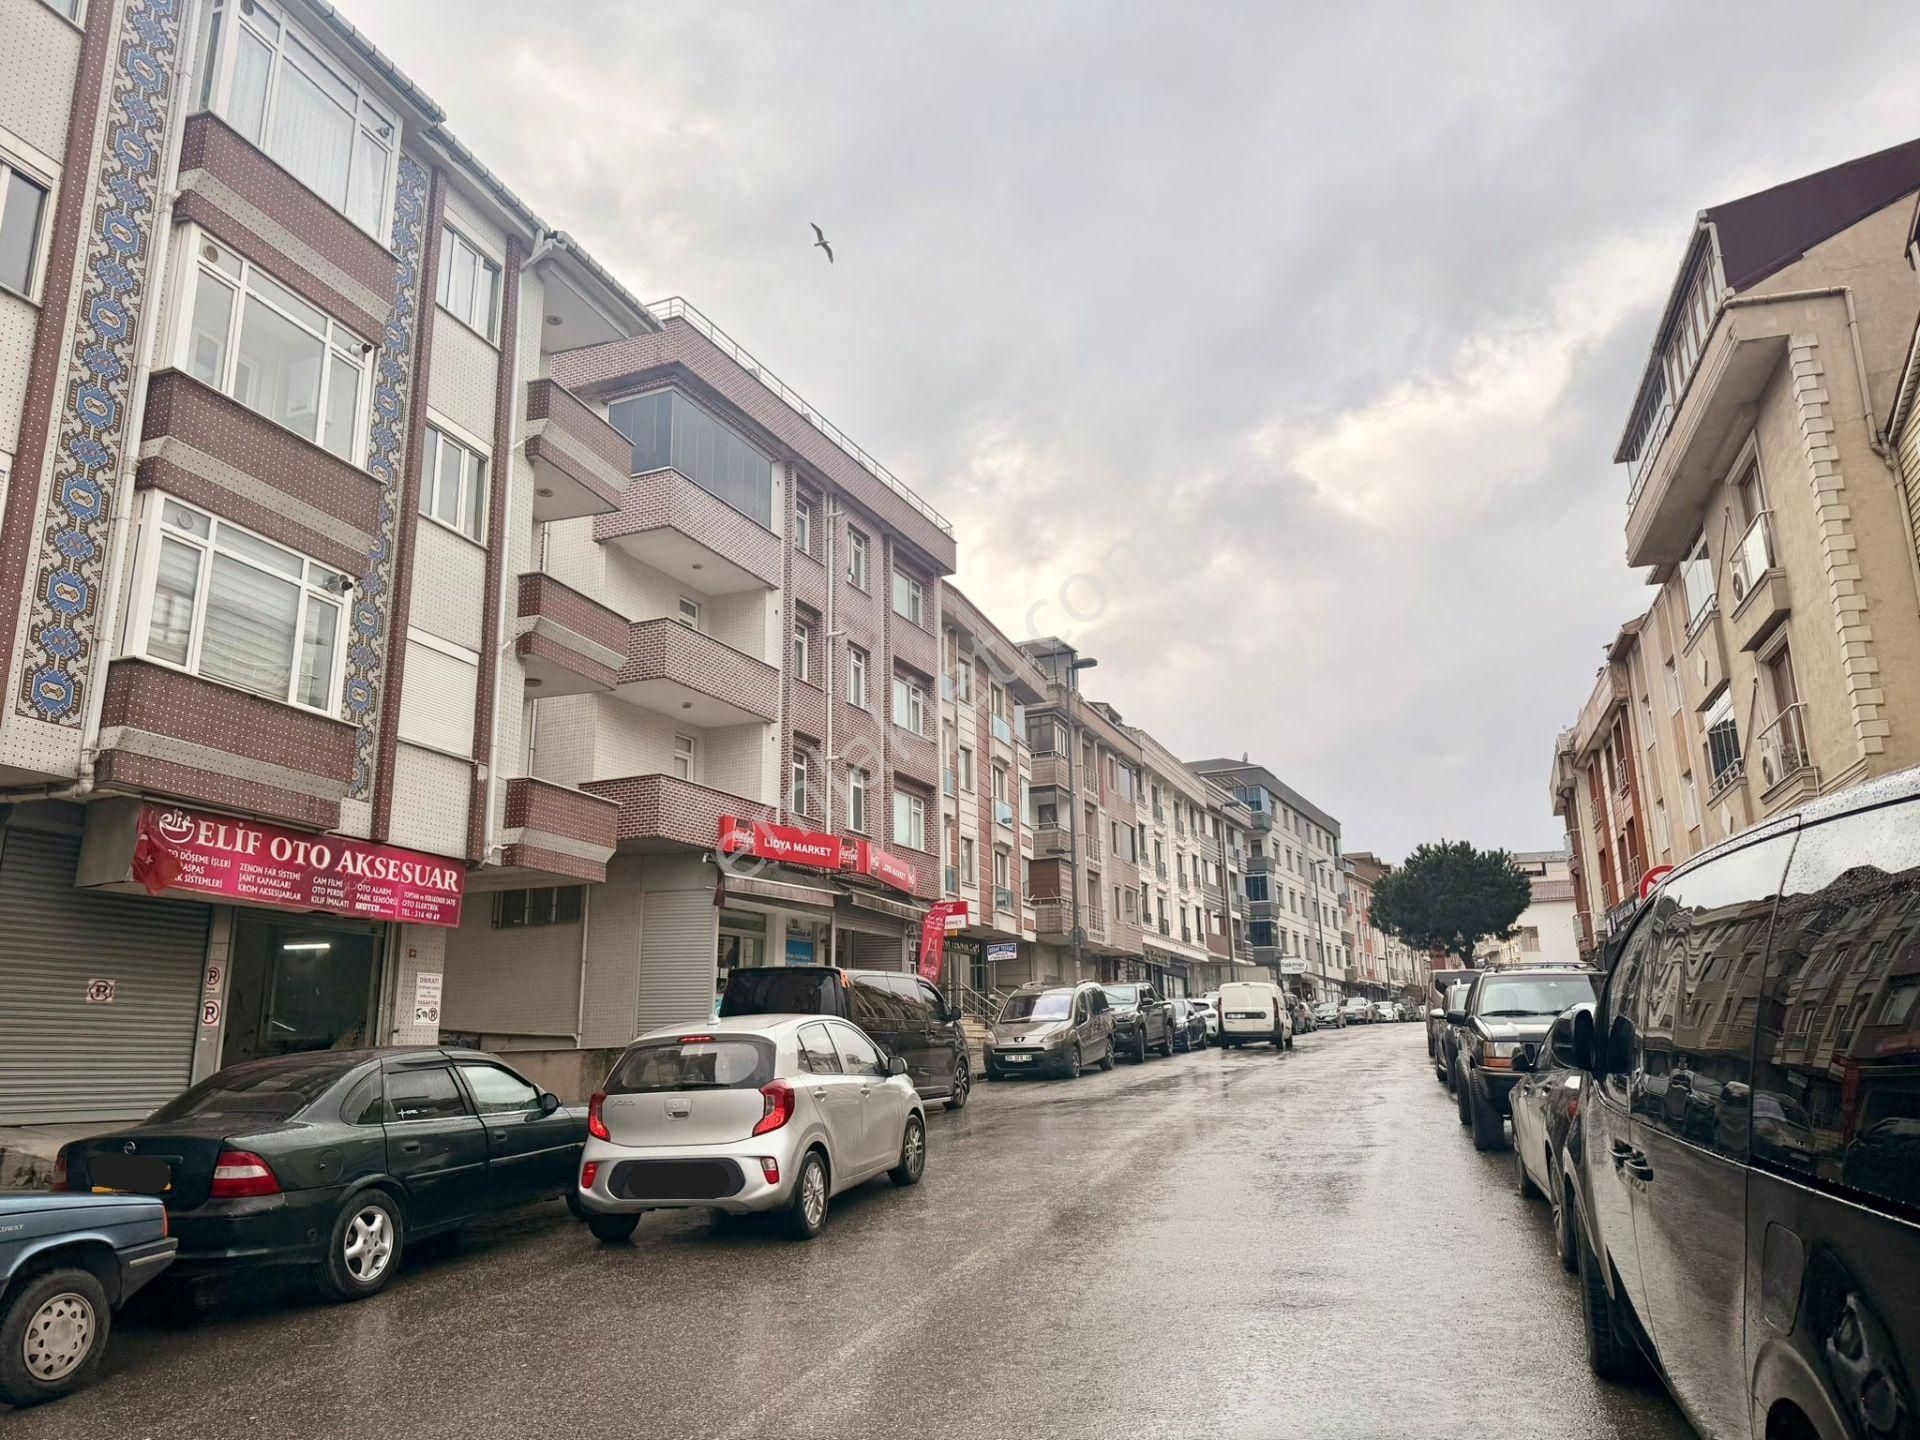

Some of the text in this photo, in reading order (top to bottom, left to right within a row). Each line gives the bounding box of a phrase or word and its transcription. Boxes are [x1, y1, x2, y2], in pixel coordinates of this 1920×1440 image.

[764, 837, 832, 857] LİDYA MARKET
[196, 820, 459, 893] ELİF OTO AKSESUAR
[312, 887, 326, 896] OTO
[357, 883, 371, 893] OTO
[402, 899, 415, 907] OTO
